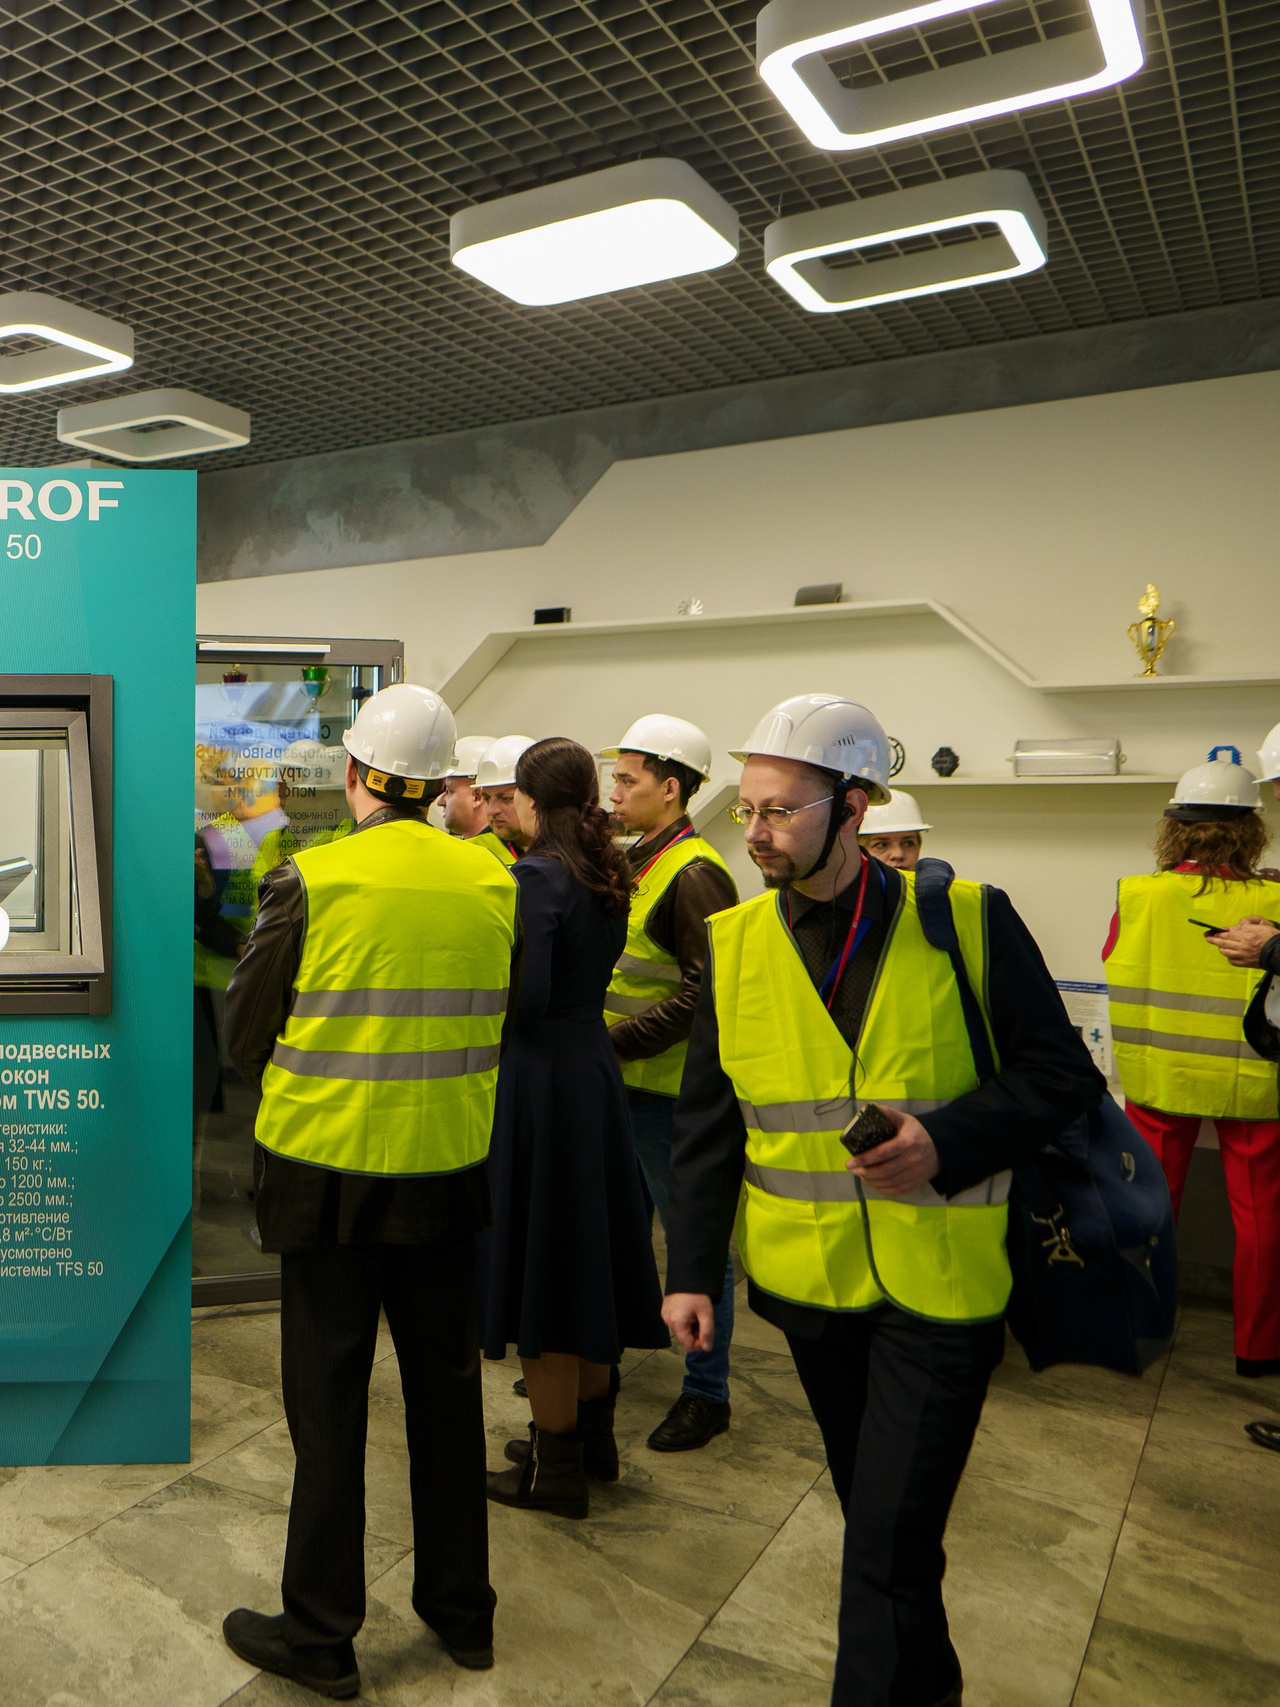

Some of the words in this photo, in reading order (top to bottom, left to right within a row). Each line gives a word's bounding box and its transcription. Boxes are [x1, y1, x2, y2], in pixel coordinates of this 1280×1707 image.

[7, 534, 41, 559] 50
[1, 1069, 49, 1084] окон
[24, 1089, 70, 1109] TWS
[77, 1089, 104, 1109] 50.
[9, 1138, 45, 1152] 32-44
[51, 1142, 77, 1154] мм.;
[5, 1156, 28, 1170] 150
[33, 1160, 51, 1172] кг.;
[12, 1174, 42, 1188] 1200
[48, 1177, 74, 1189] мм.;
[9, 1192, 40, 1206] 2500
[46, 1195, 72, 1207] мм.;
[56, 1262, 83, 1276] TFS
[88, 1262, 103, 1275] 50
